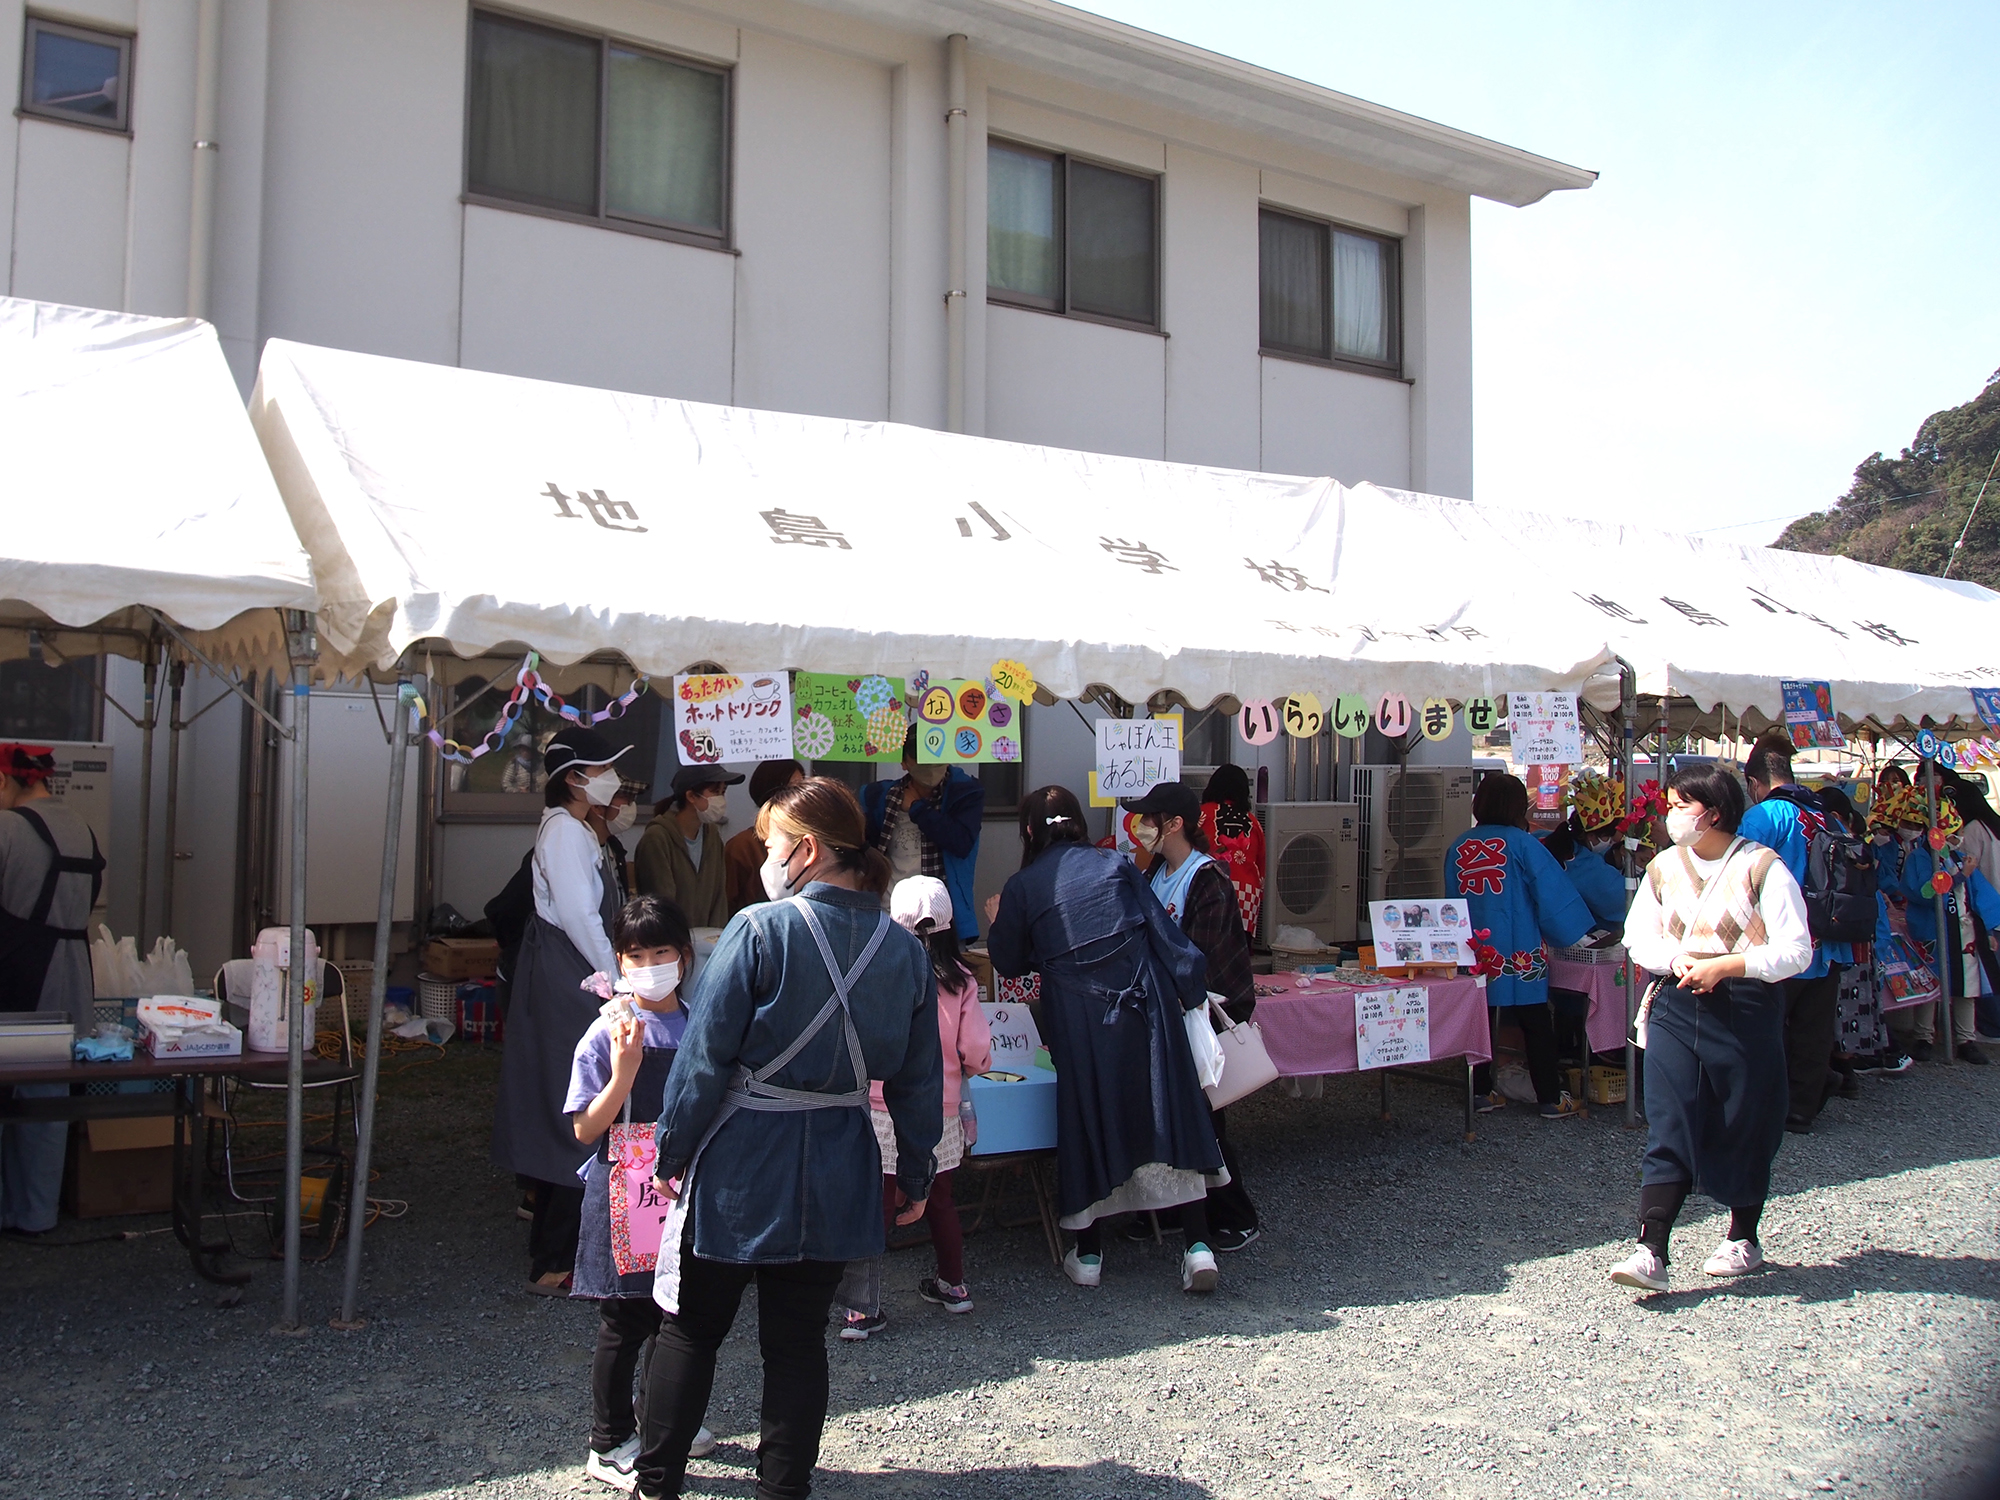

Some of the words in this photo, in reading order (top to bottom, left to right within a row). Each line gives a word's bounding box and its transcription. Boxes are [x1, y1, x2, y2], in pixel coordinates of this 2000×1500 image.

[680, 677, 739, 700] あったかい
[815, 685, 847, 697] コーヒー
[813, 698, 857, 710] カフェオレ
[685, 700, 782, 724] ホットドリンク
[831, 714, 855, 728] 紅茶
[1243, 697, 1493, 741] いらっしゃいませ
[835, 732, 864, 742] いろいろ
[1104, 724, 1177, 751] しゃぼん玉
[842, 743, 864, 754] あるよ
[1540, 772, 1559, 782] 1000
[1455, 837, 1507, 895] 祭
[464, 1019, 499, 1032] CITY
